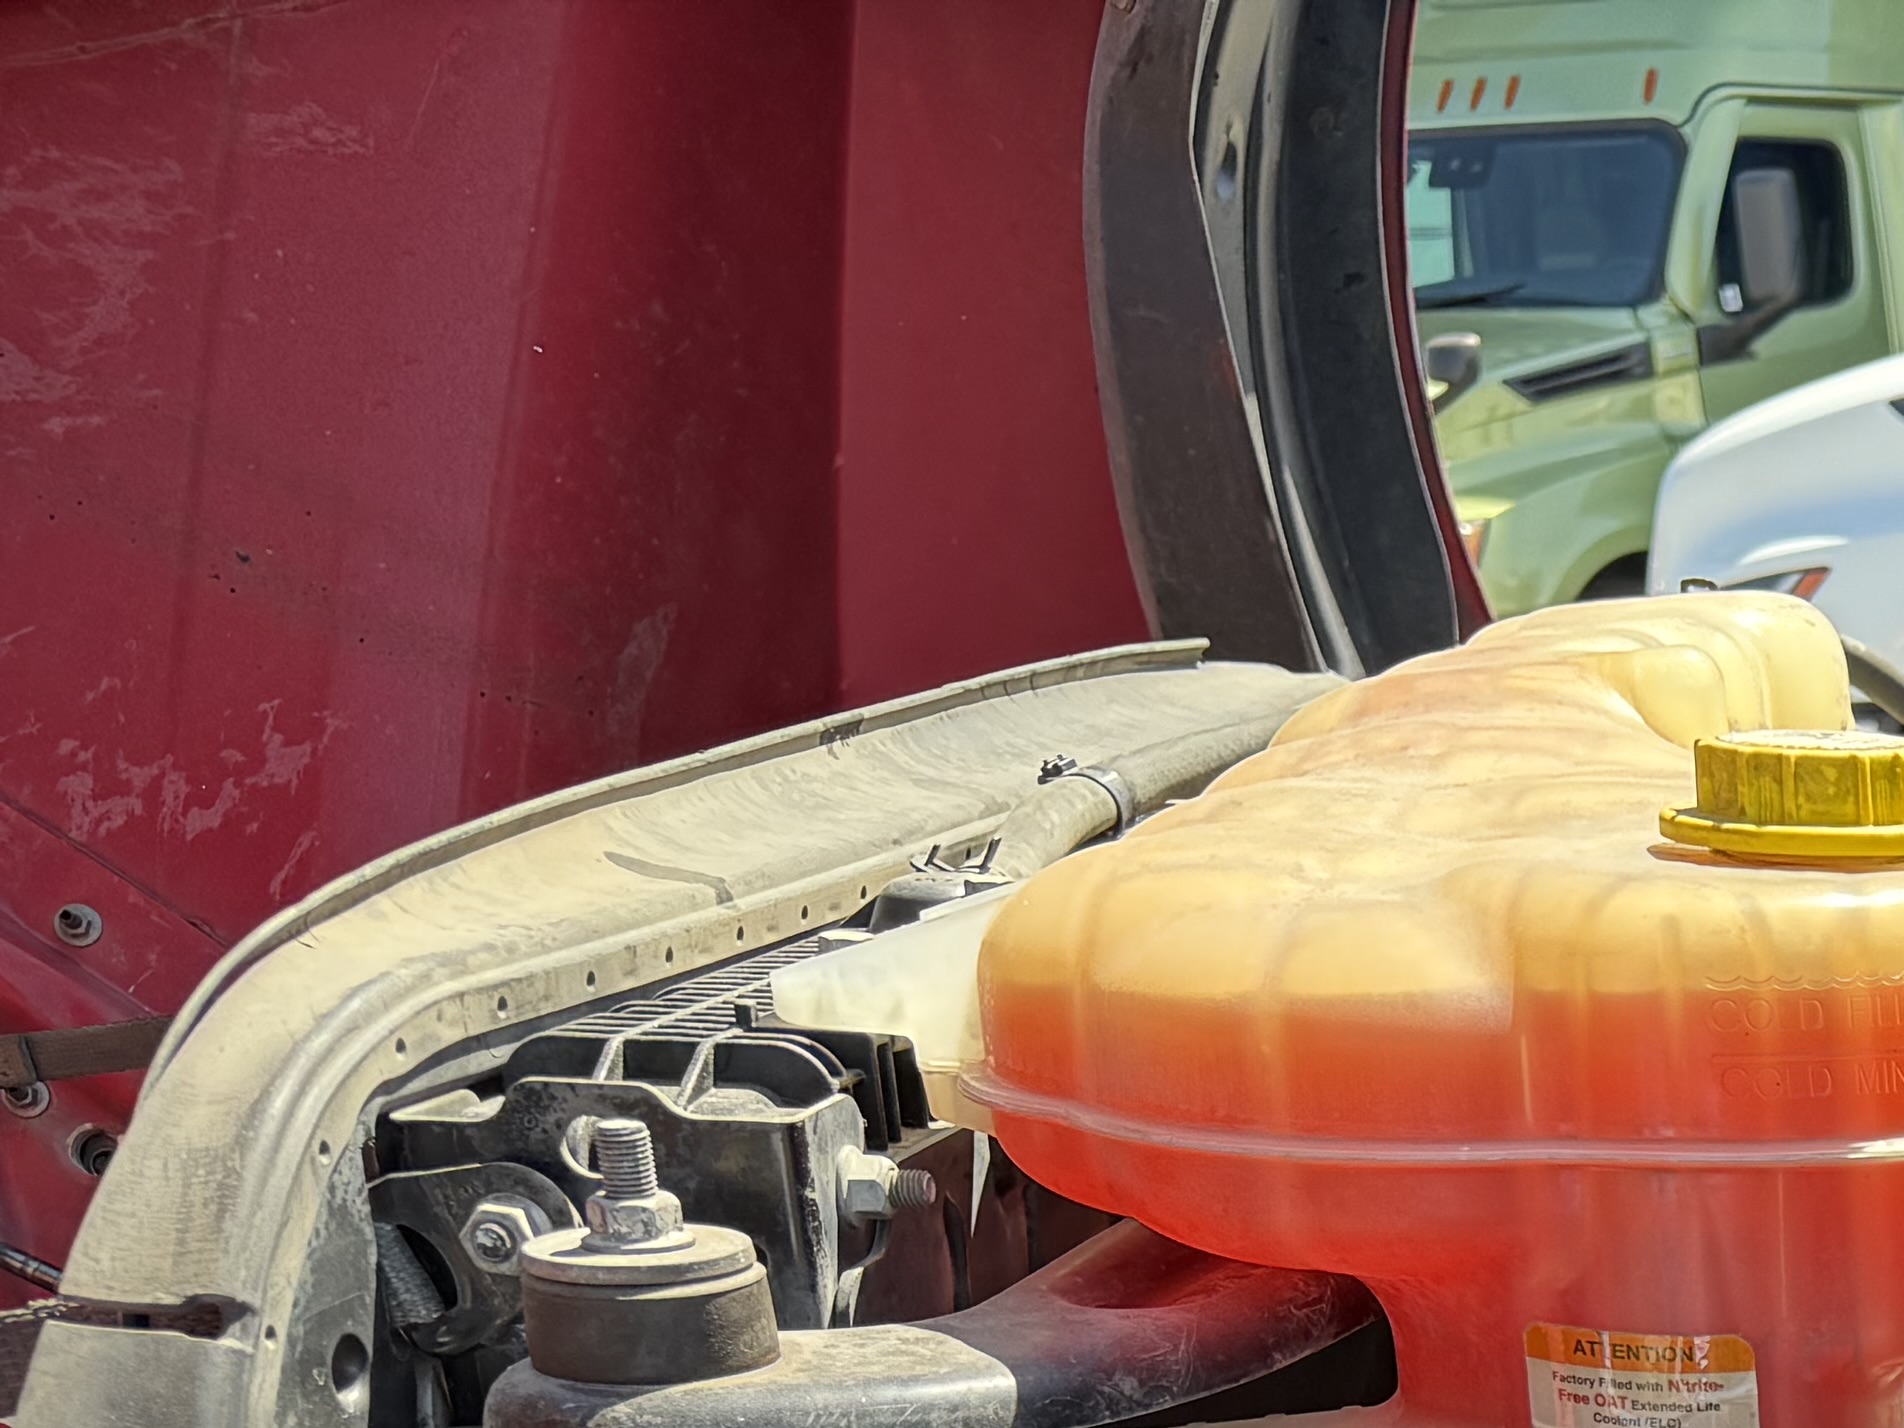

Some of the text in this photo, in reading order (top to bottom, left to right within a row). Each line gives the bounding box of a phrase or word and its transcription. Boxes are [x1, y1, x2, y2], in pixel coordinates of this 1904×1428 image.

[1709, 997, 1824, 1033] COLD
[1720, 1065, 1834, 1099] COLD
[1573, 1339, 1694, 1363] ATENTION
[1552, 1371, 1596, 1390] Factory
[1636, 1379, 1664, 1393] with
[1558, 1389, 1721, 1413] Free OAT Extended Life
[1593, 1412, 1641, 1427] Coolant
